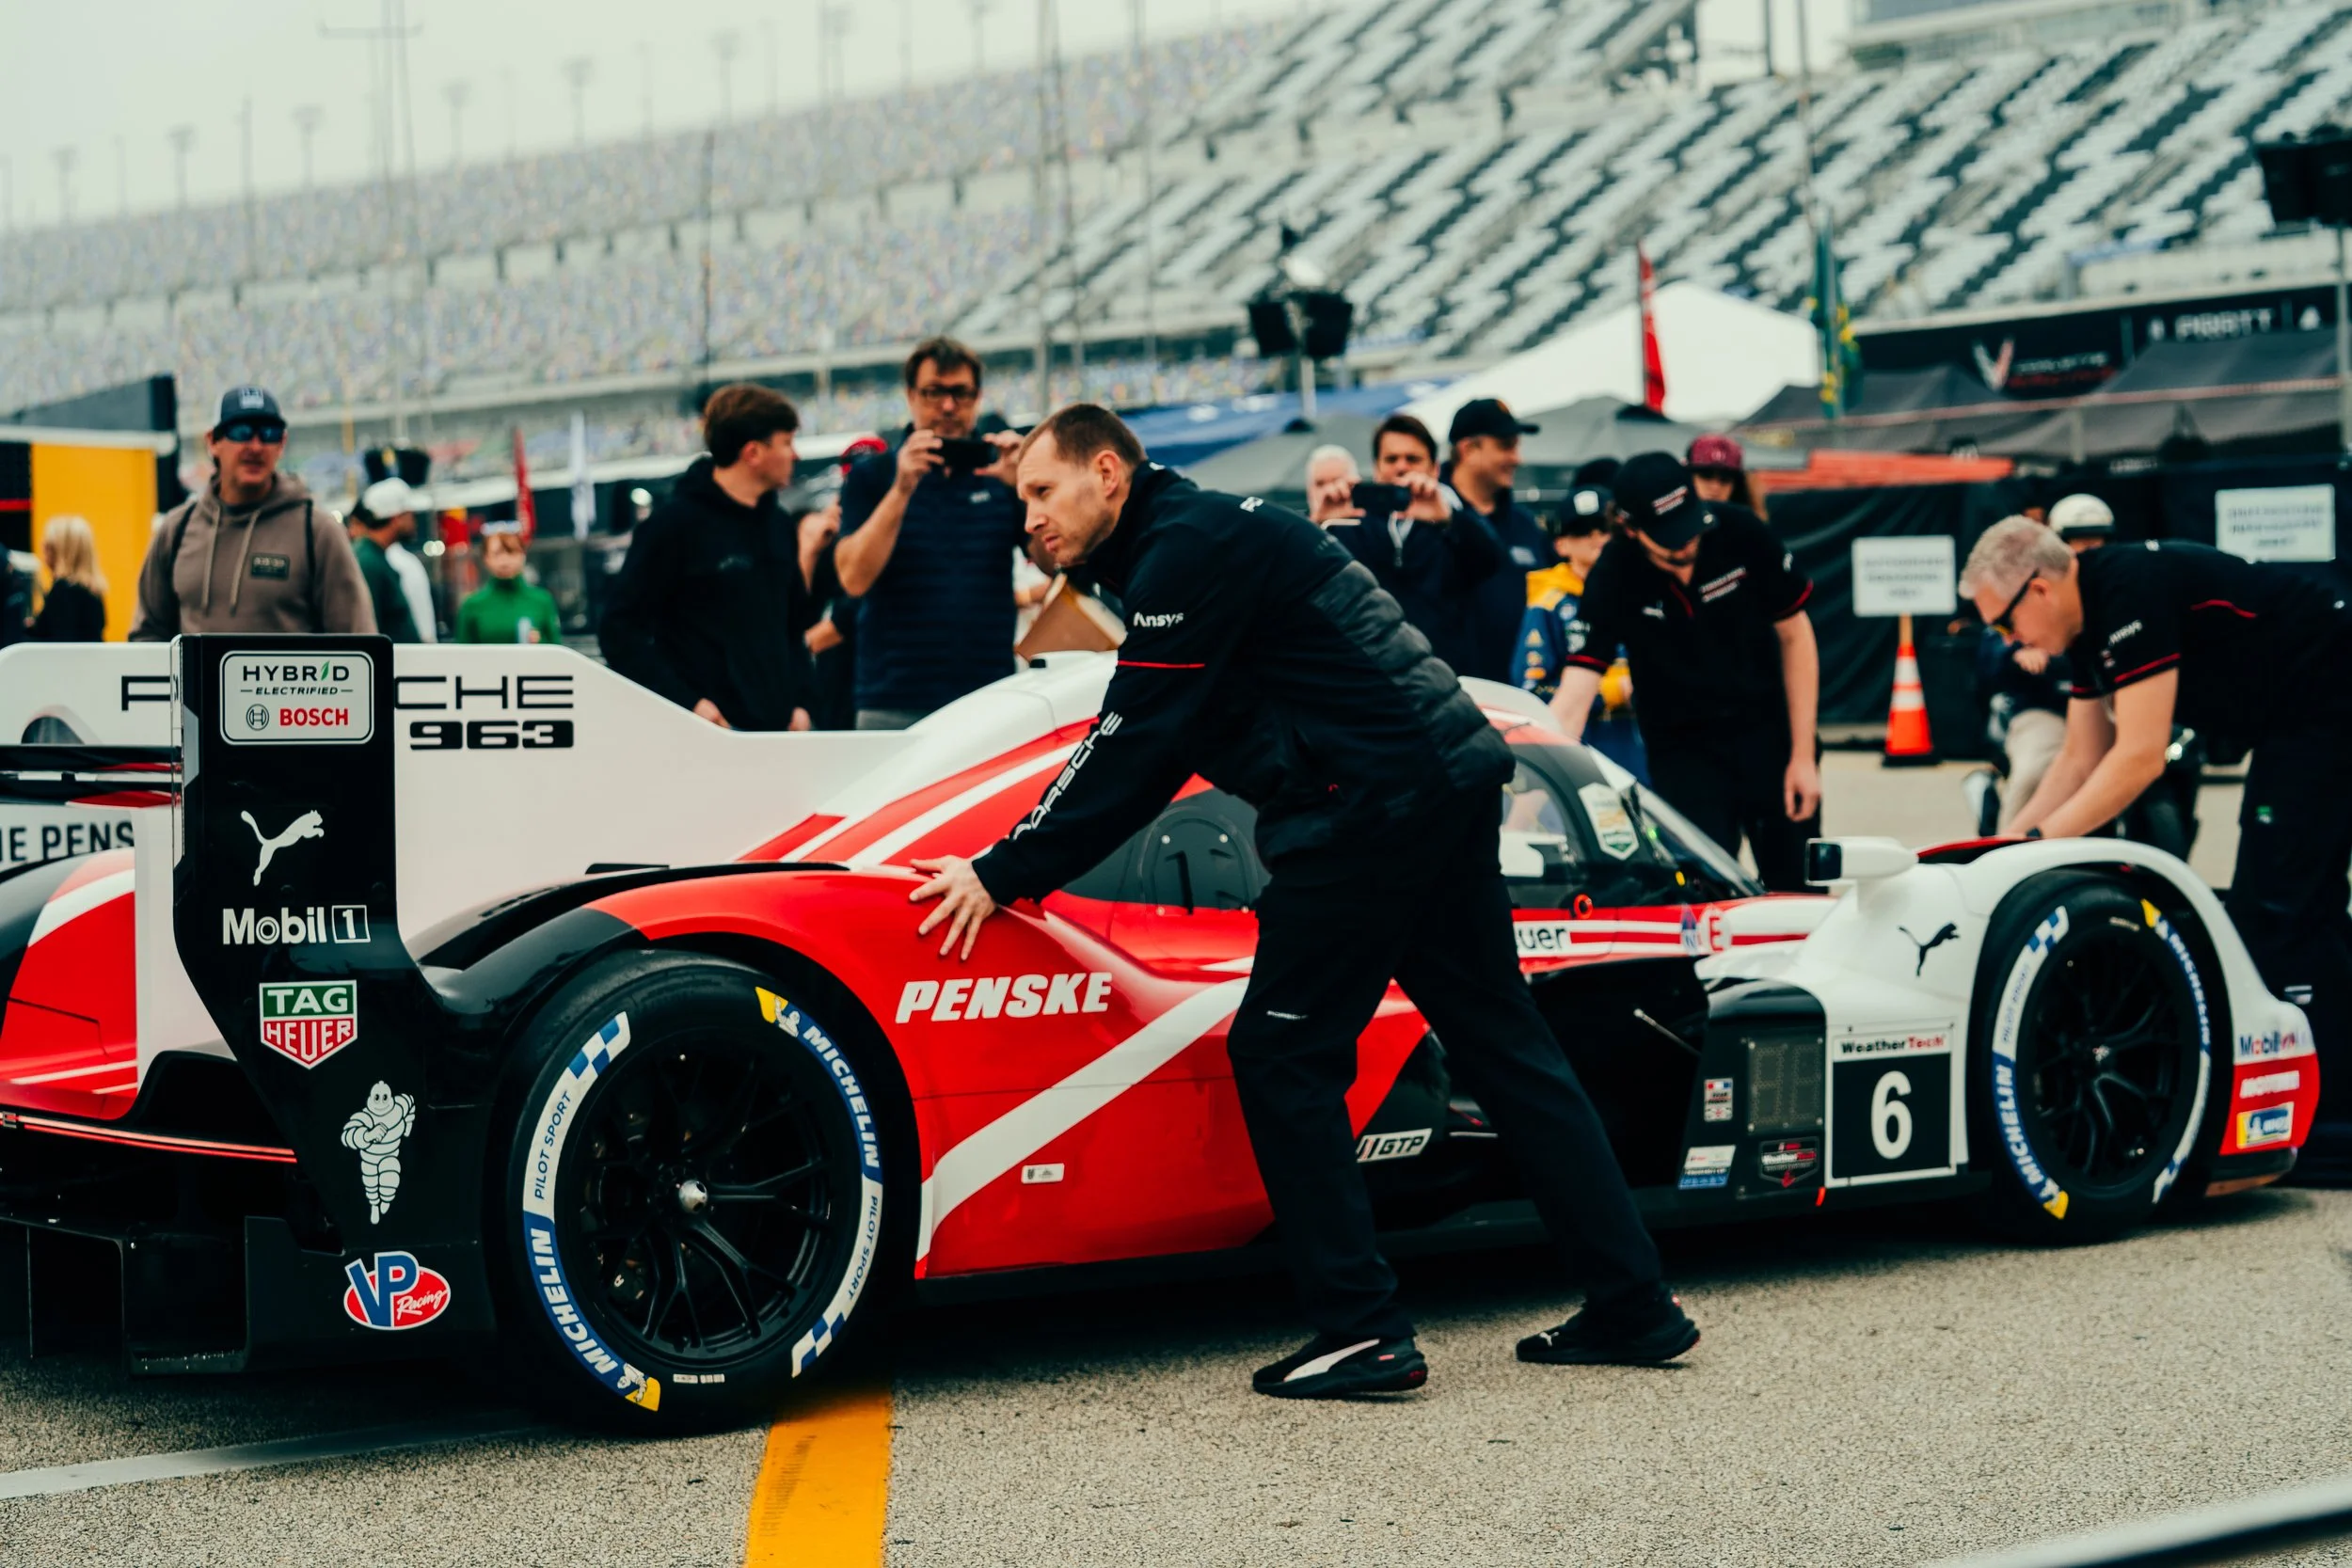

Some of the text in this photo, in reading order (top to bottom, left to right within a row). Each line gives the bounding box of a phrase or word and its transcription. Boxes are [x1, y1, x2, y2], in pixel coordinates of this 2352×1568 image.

[255, 686, 339, 696] ELECTRIFIED
[279, 707, 349, 727] BOSCH
[409, 720, 574, 751] 963
[222, 907, 327, 945] Mobil
[1708, 916, 1724, 952] E
[267, 987, 348, 1015] TAG
[895, 972, 1113, 1024] PENSKE
[265, 1020, 352, 1061] HEUER
[803, 1025, 880, 1168] MICHELIN
[1870, 1069, 1914, 1160] 6
[534, 1089, 572, 1200] PILOT SPORT
[1378, 1135, 1425, 1155] GTP
[1995, 1064, 2044, 1185] MICHELIN
[848, 1195, 880, 1300] PILOT SPORT
[344, 1251, 449, 1328] VP Racing
[531, 1227, 619, 1374] MICHELIN
